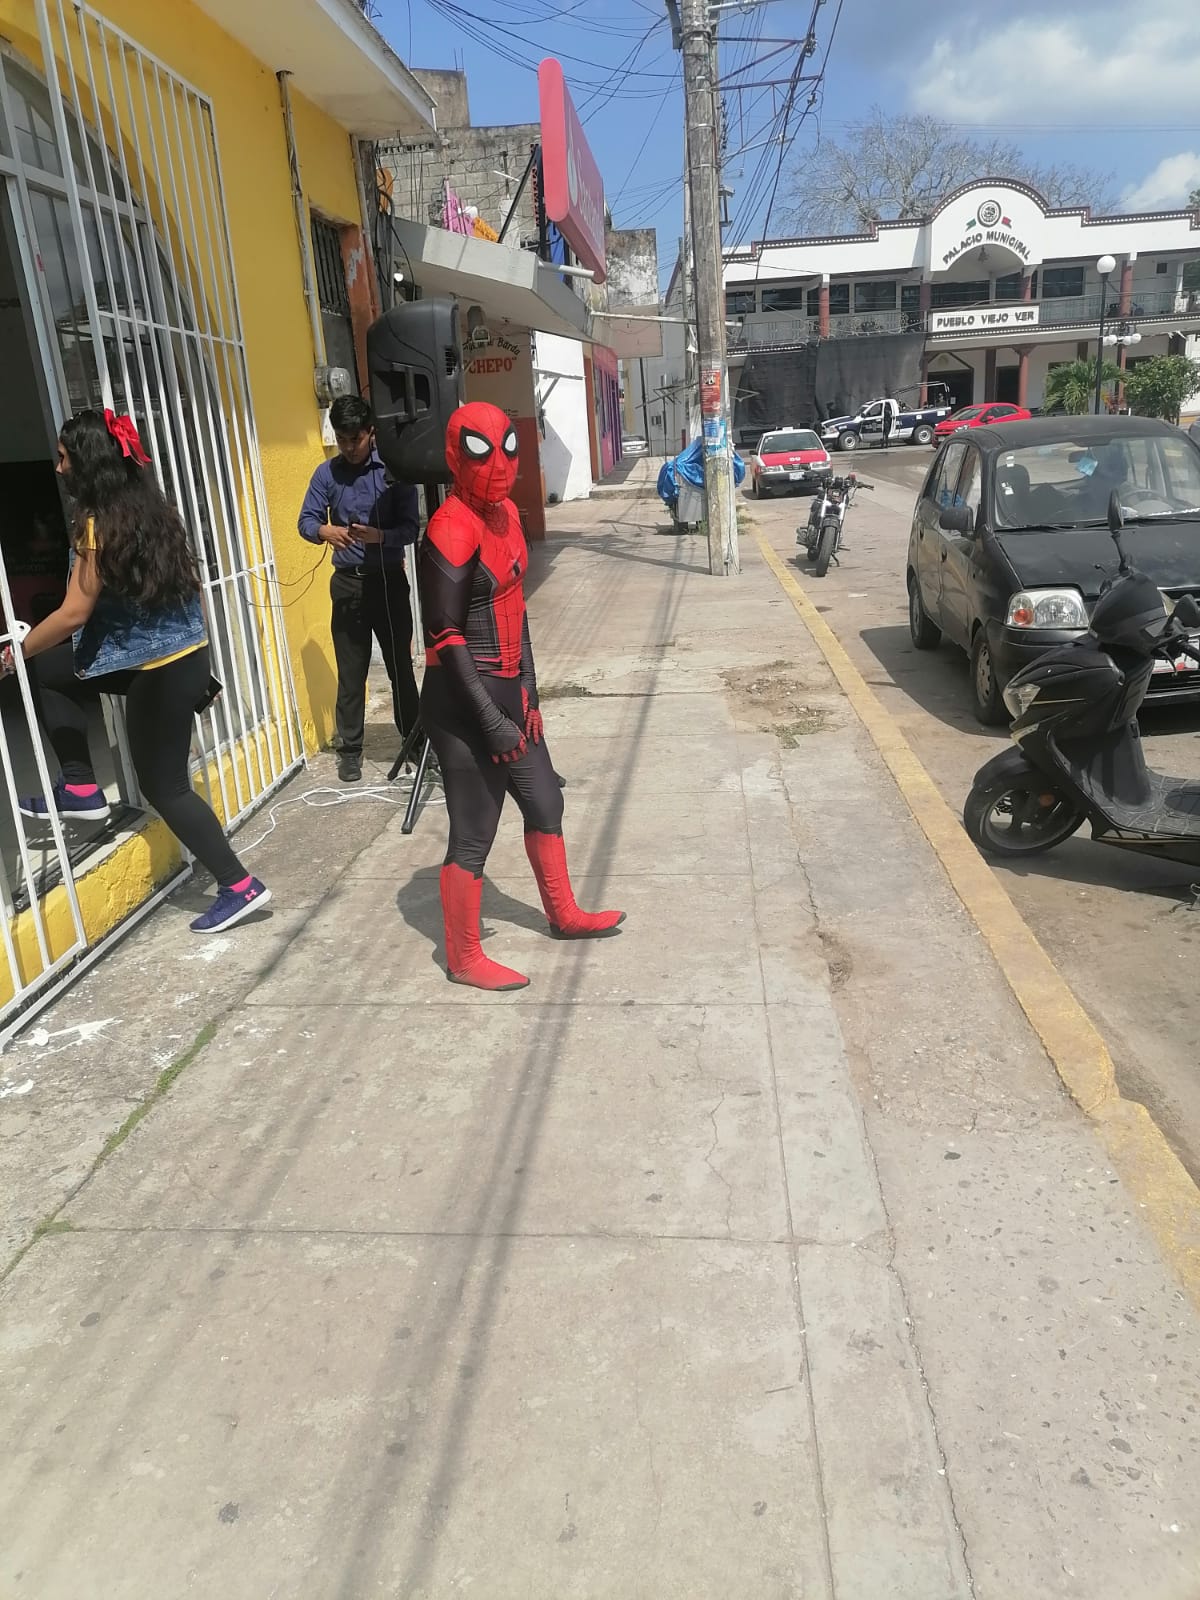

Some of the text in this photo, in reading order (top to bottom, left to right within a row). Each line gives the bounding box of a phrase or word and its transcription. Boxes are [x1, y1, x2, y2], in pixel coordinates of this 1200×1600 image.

[943, 231, 1031, 264] PALACIO MUNICIPAL
[937, 311, 1034, 328] PUEBLO VIEJO VER
[497, 336, 520, 356] Barda
